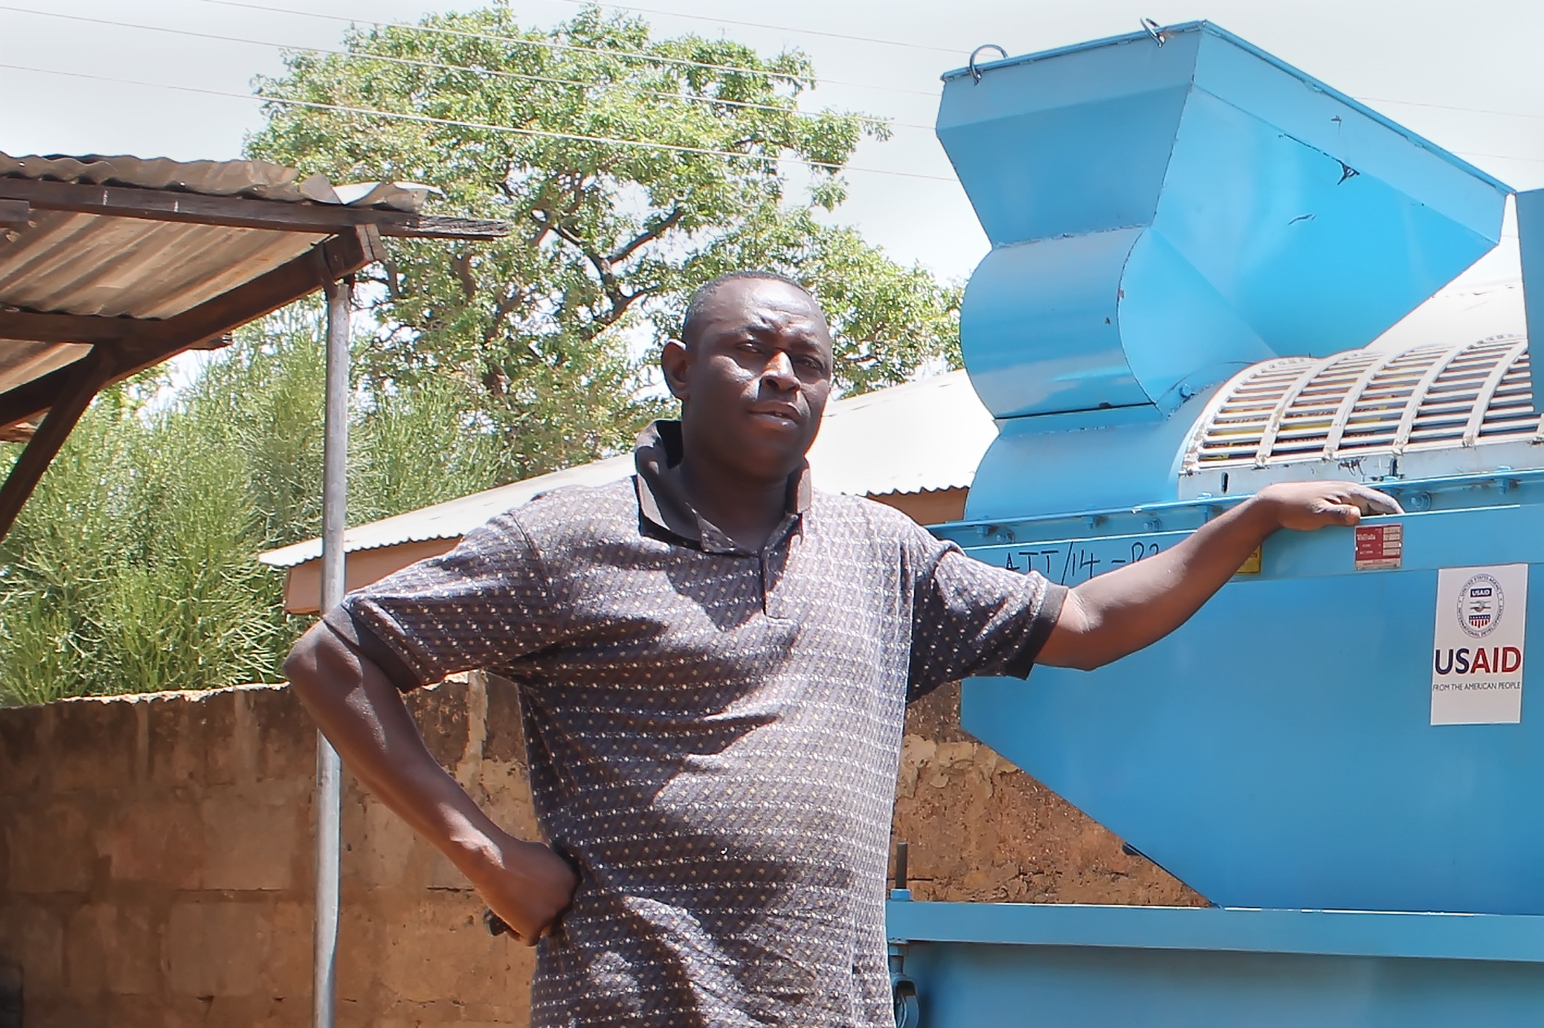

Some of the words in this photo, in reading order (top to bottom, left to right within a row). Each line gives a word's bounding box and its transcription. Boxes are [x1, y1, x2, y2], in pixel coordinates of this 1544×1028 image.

[1435, 646, 1522, 675] USAID
[1433, 683, 1450, 691] FROM
[1451, 683, 1463, 691] THE
[1464, 682, 1497, 691] AMERICAN
[1498, 681, 1521, 690] PEOPLE
